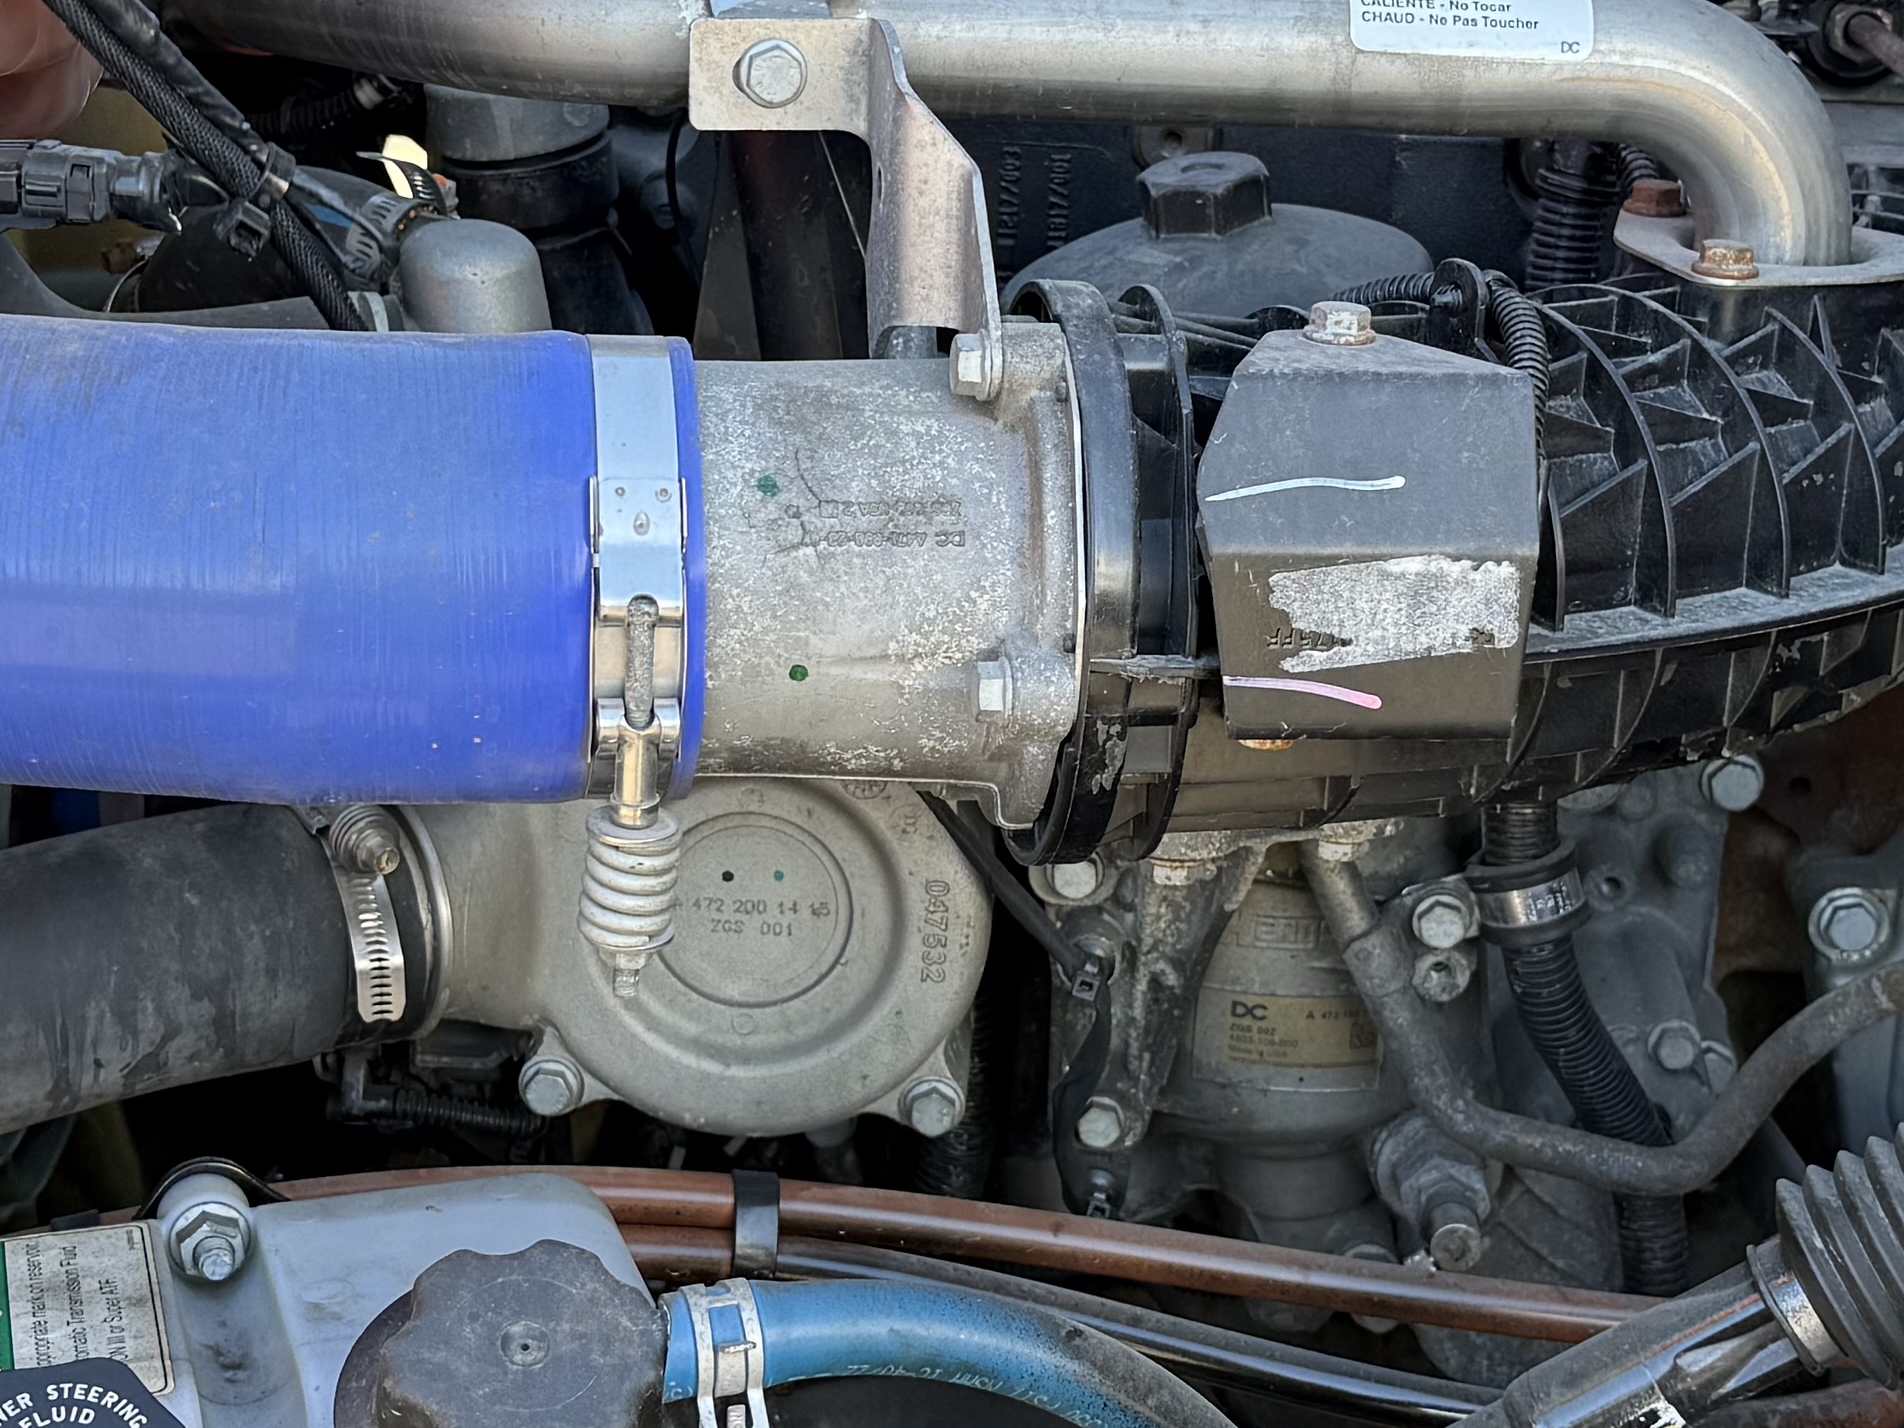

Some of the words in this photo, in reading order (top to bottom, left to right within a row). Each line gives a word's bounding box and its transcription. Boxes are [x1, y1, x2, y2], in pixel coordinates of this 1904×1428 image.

[1448, 0, 1469, 12] No
[1472, 1, 1512, 13] Tocar
[1360, 10, 1415, 25] CHAUD
[1453, 15, 1478, 28] Pas
[1482, 17, 1539, 30] Toucher
[1560, 41, 1581, 54] DC
[692, 896, 725, 913] 472
[732, 899, 768, 916] 200
[1230, 999, 1268, 1021] DC
[60, 1245, 80, 1267] Fluid
[29, 1283, 44, 1296] on
[64, 1268, 86, 1327] Transmission
[31, 1295, 46, 1318] mark
[103, 1296, 125, 1324] Super
